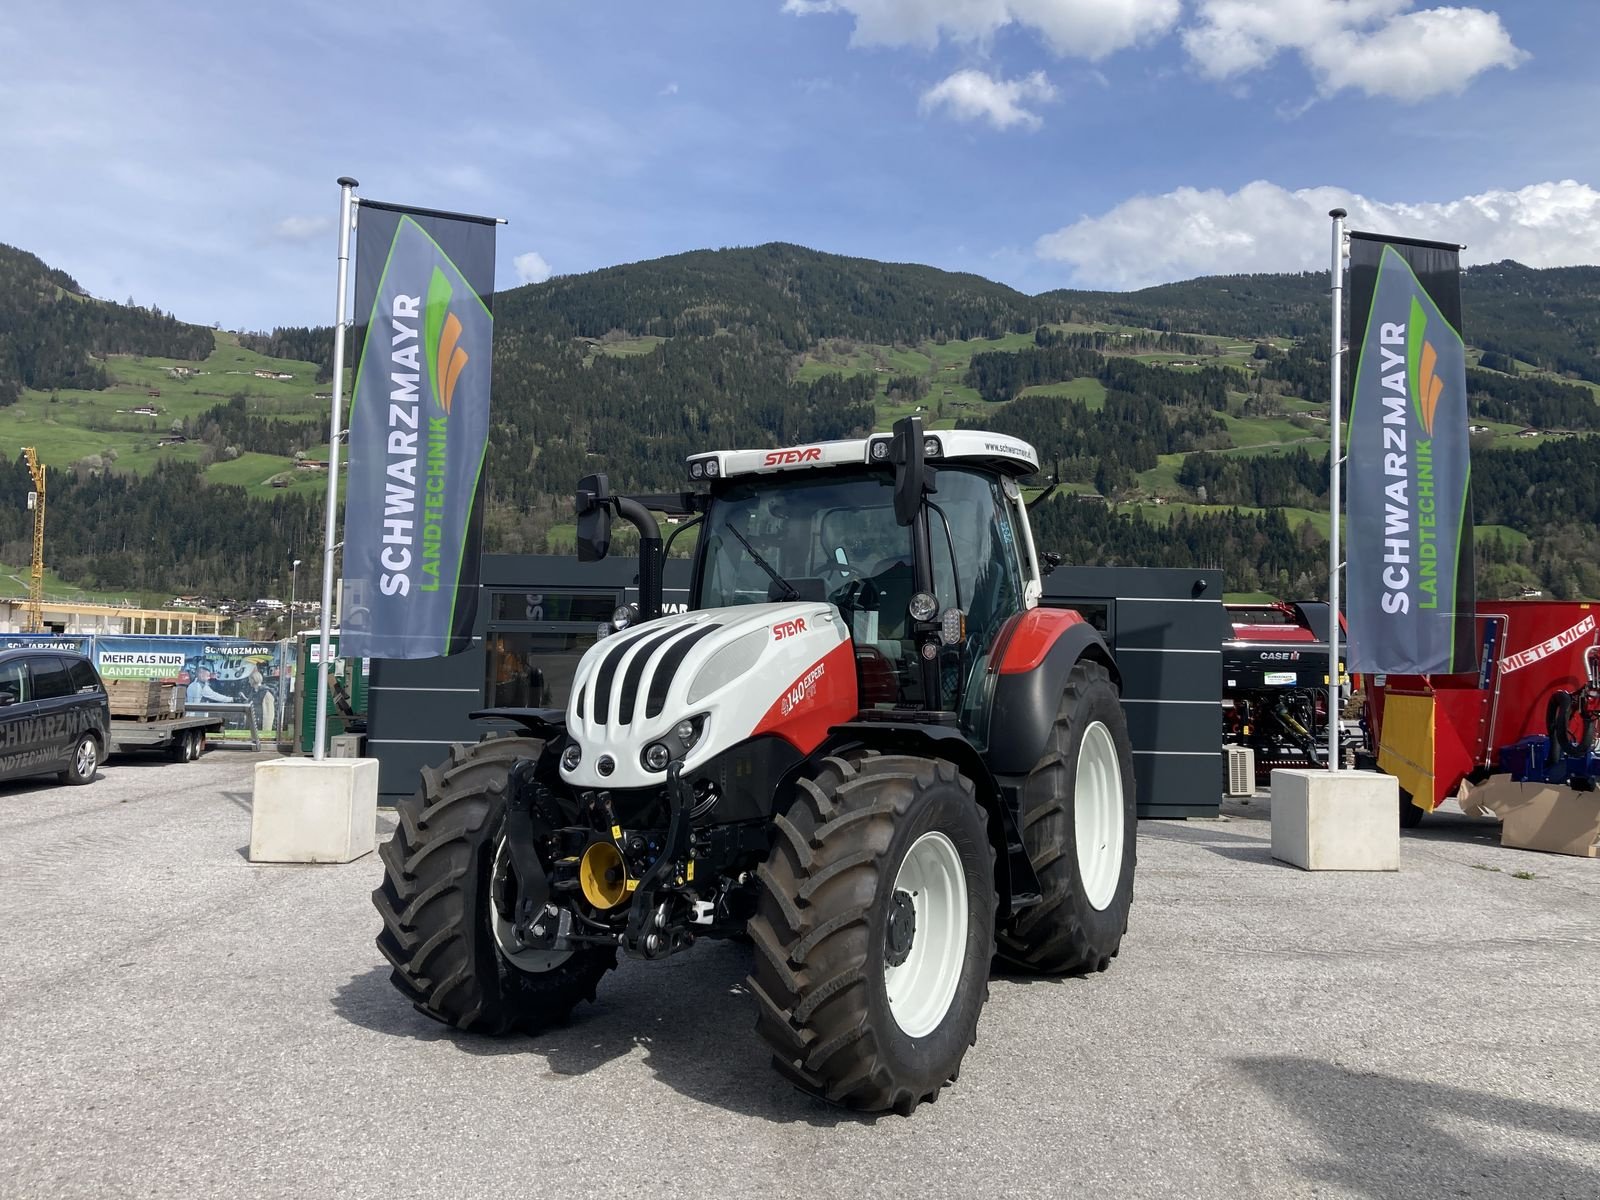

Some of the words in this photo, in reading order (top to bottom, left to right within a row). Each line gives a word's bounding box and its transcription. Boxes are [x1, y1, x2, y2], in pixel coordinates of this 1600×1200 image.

[380, 293, 421, 597] SCHWARZMAYR
[763, 447, 822, 466] STEYR
[1380, 321, 1410, 616] SCHWARZMAYR
[420, 415, 448, 592] LANDTECHNIK
[1414, 438, 1438, 610] LANDTECHNIK
[773, 617, 807, 641] STEYR
[1260, 652, 1289, 660] CASE
[1501, 641, 1554, 673] MIETE
[1556, 616, 1595, 647] MICH
[101, 666, 176, 677] LANDTECHNIK
[102, 654, 134, 663] MEHR
[136, 655, 156, 664] ALS
[158, 656, 182, 664] NUR
[803, 663, 825, 689] EXPERT
